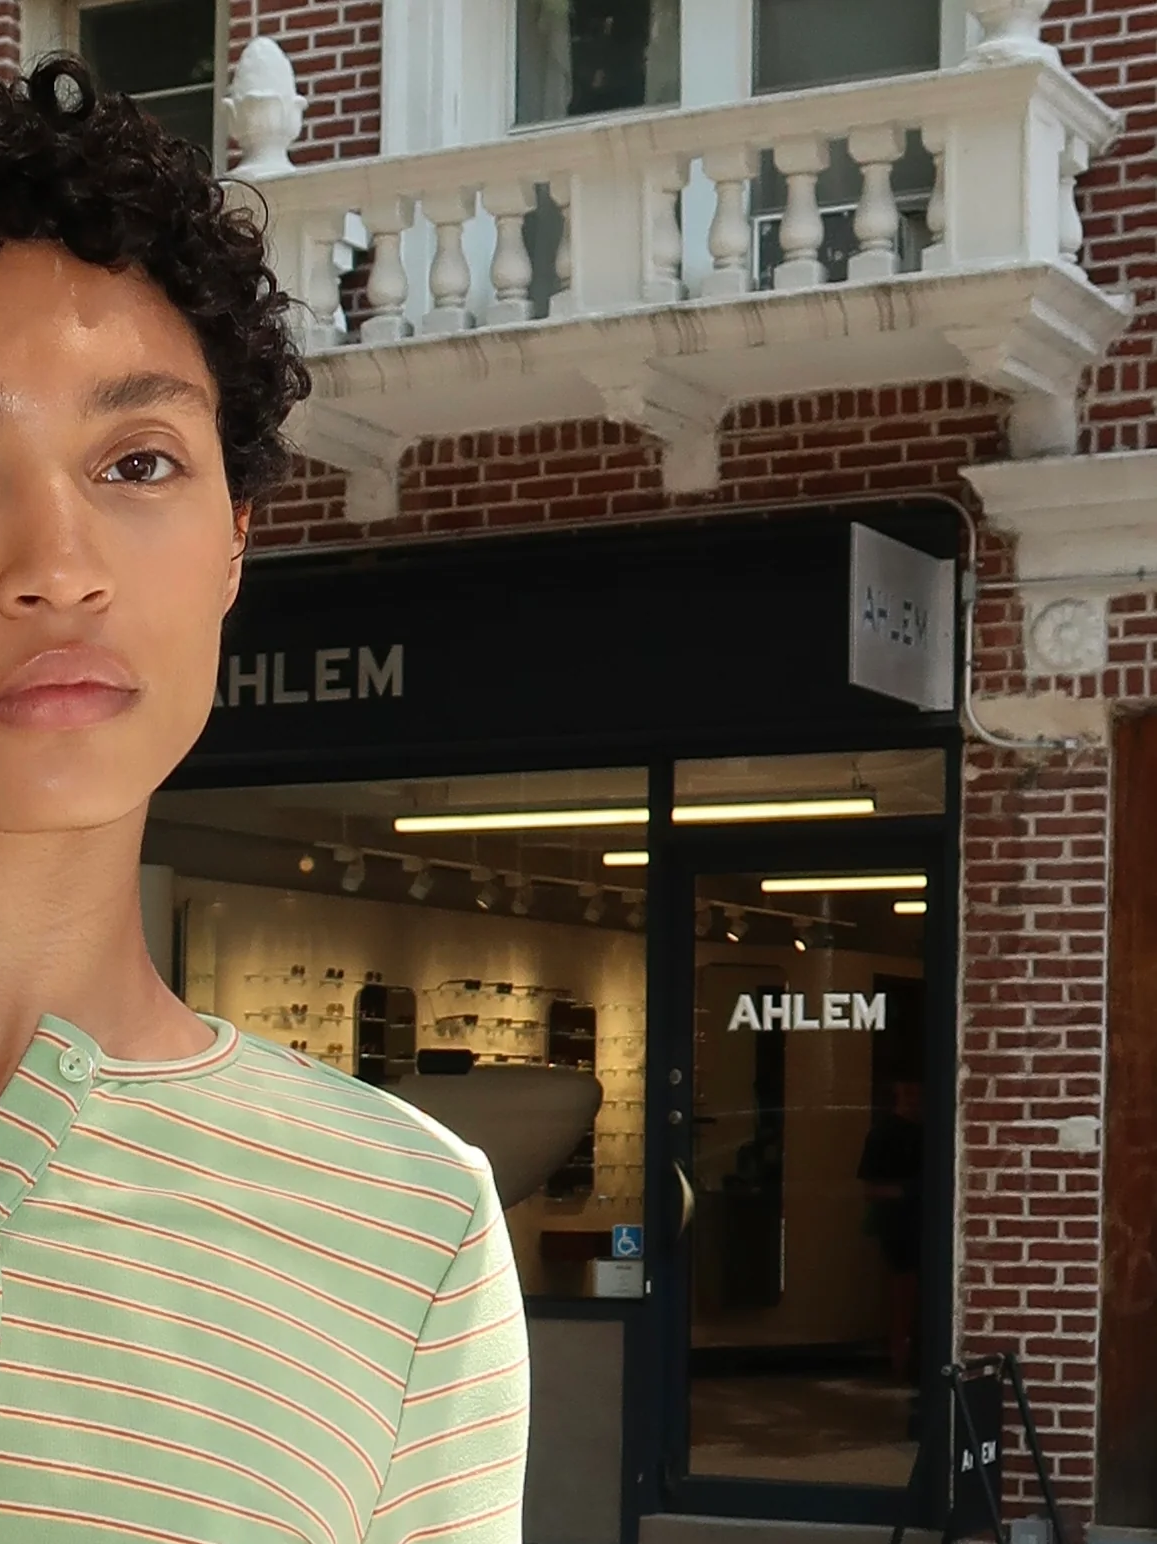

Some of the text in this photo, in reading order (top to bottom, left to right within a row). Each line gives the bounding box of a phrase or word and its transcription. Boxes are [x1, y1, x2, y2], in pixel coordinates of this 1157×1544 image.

[213, 644, 404, 707] HLEM
[728, 993, 886, 1031] AHLEM
[960, 1440, 997, 1473] AEM
